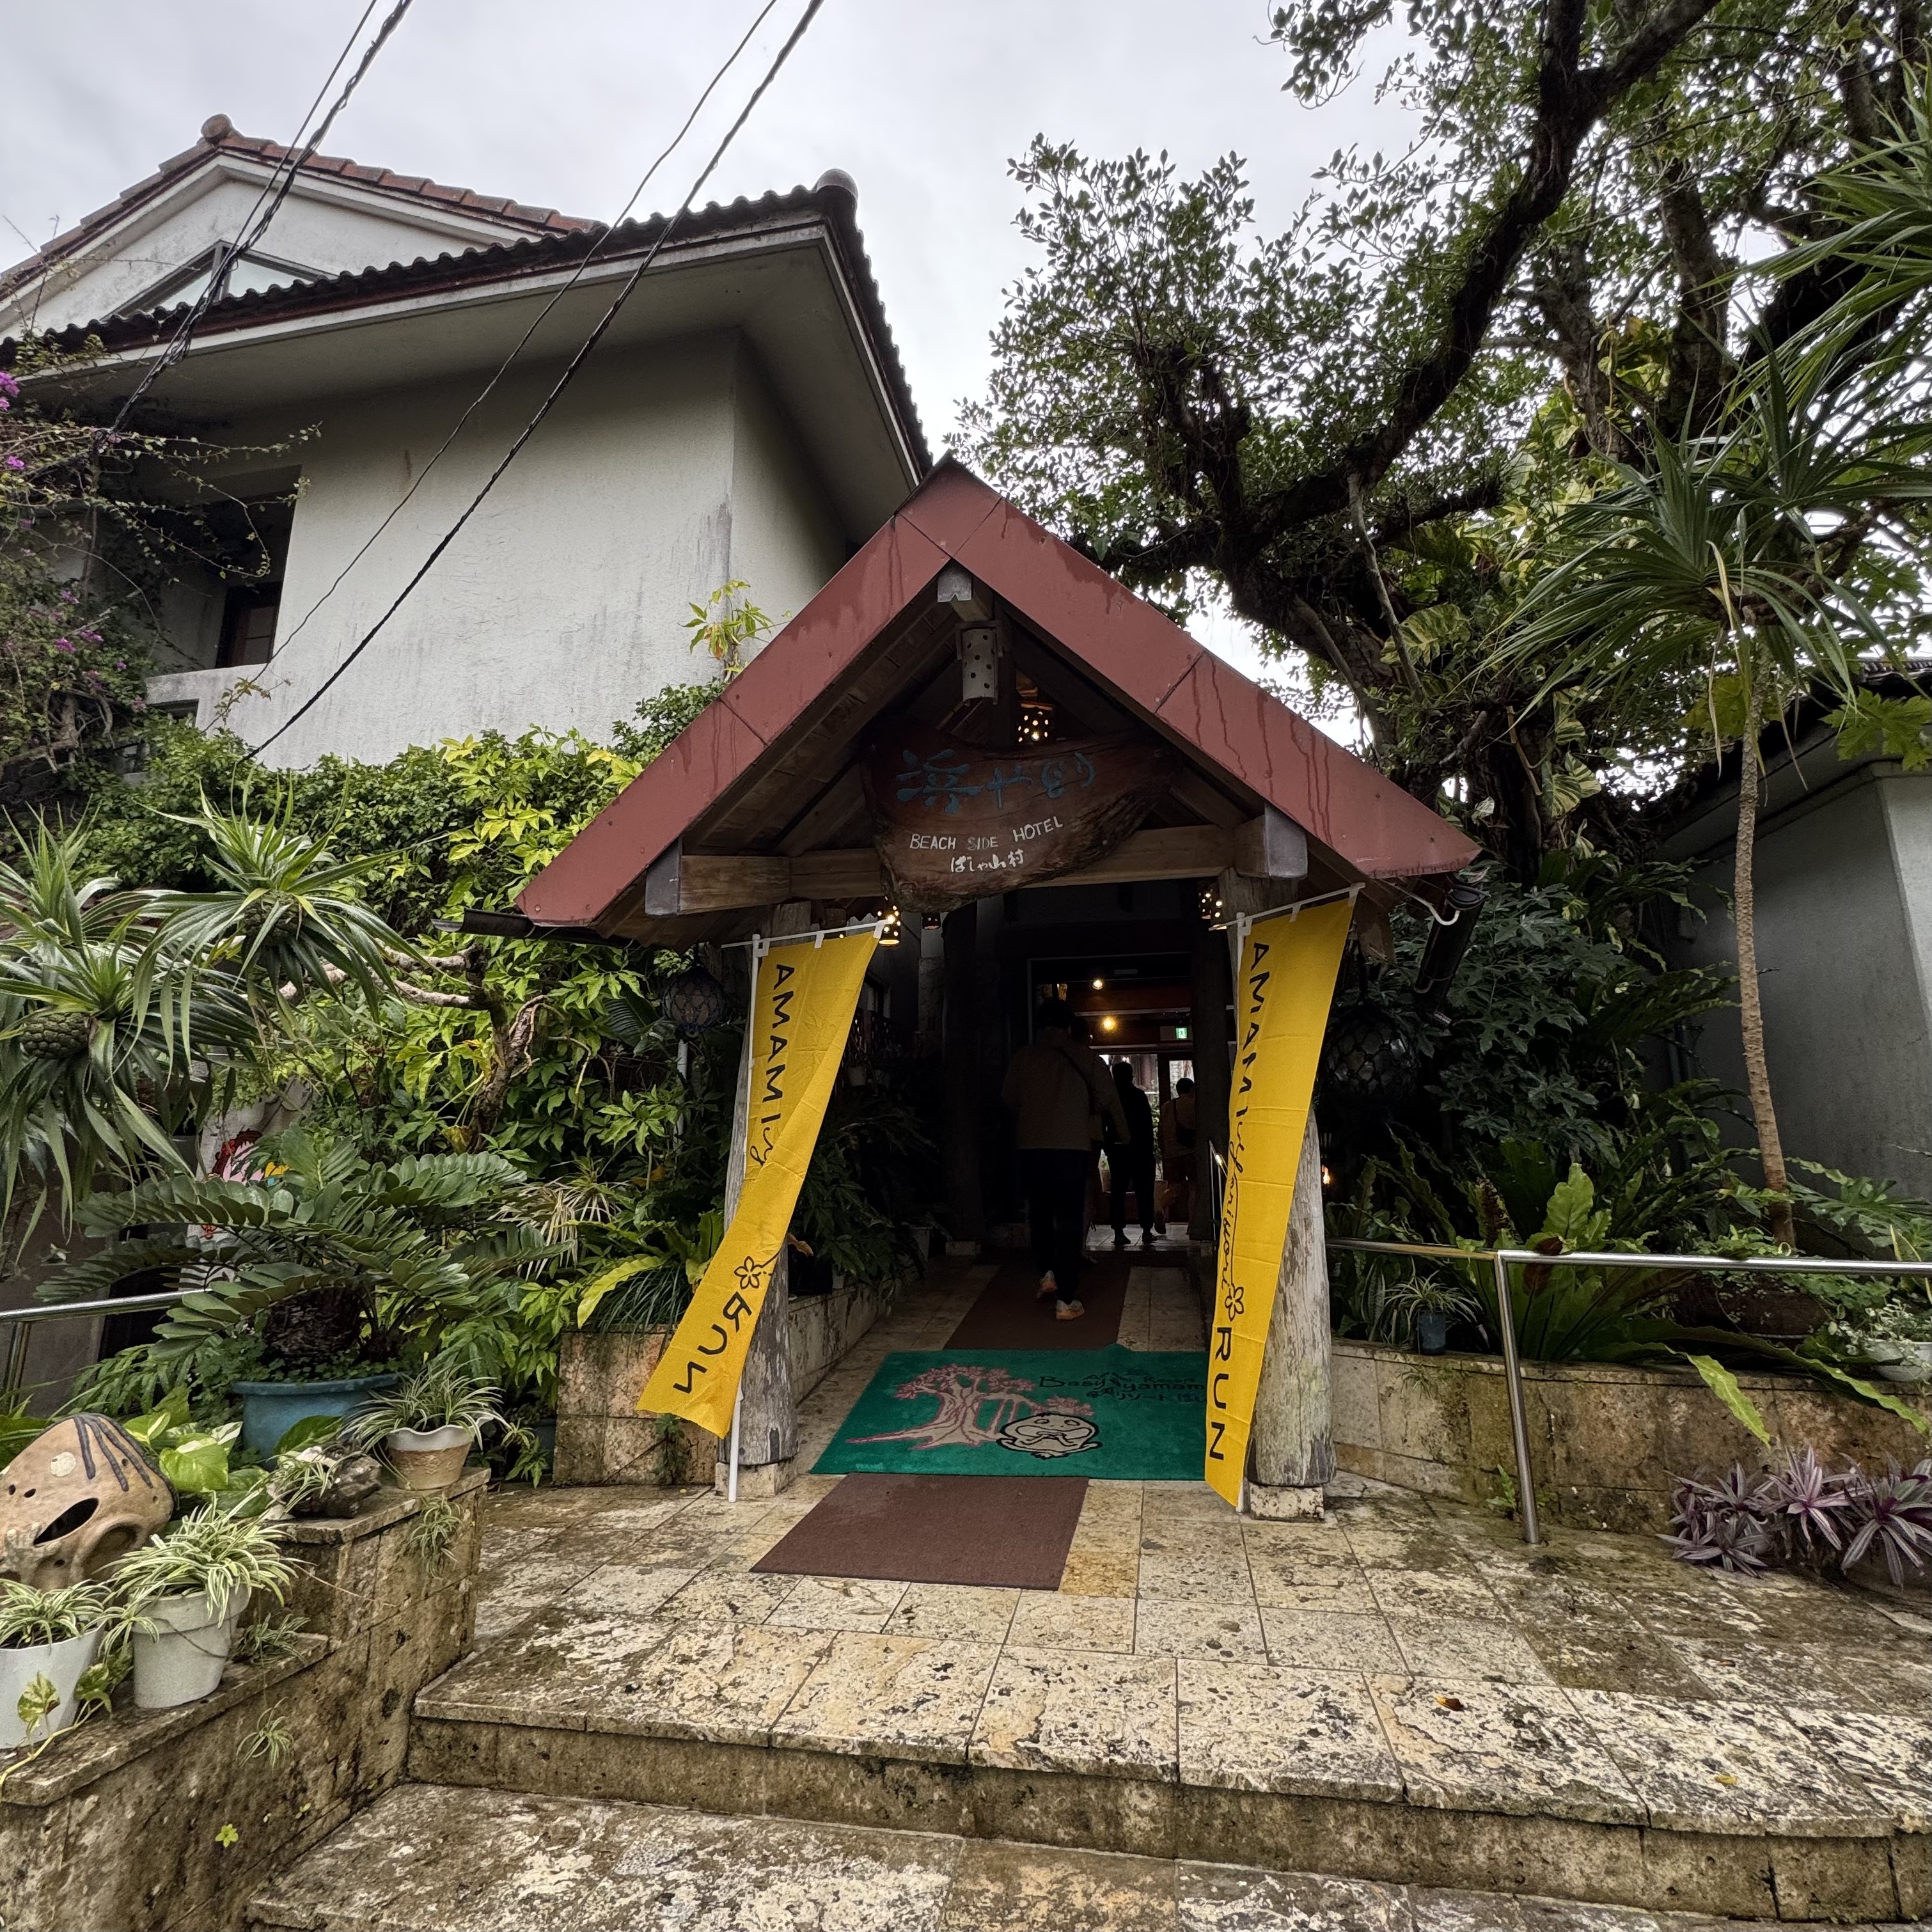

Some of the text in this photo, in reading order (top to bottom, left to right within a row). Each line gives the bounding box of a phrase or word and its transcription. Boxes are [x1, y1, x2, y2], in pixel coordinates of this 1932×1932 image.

[909, 816, 1064, 851] BEACH SIDE HOTEL
[950, 849, 1024, 873] ばしゃ山村
[761, 964, 795, 1124] AMAMI
[1236, 942, 1269, 1118] AMAMI
[1209, 1327, 1232, 1461] RUN
